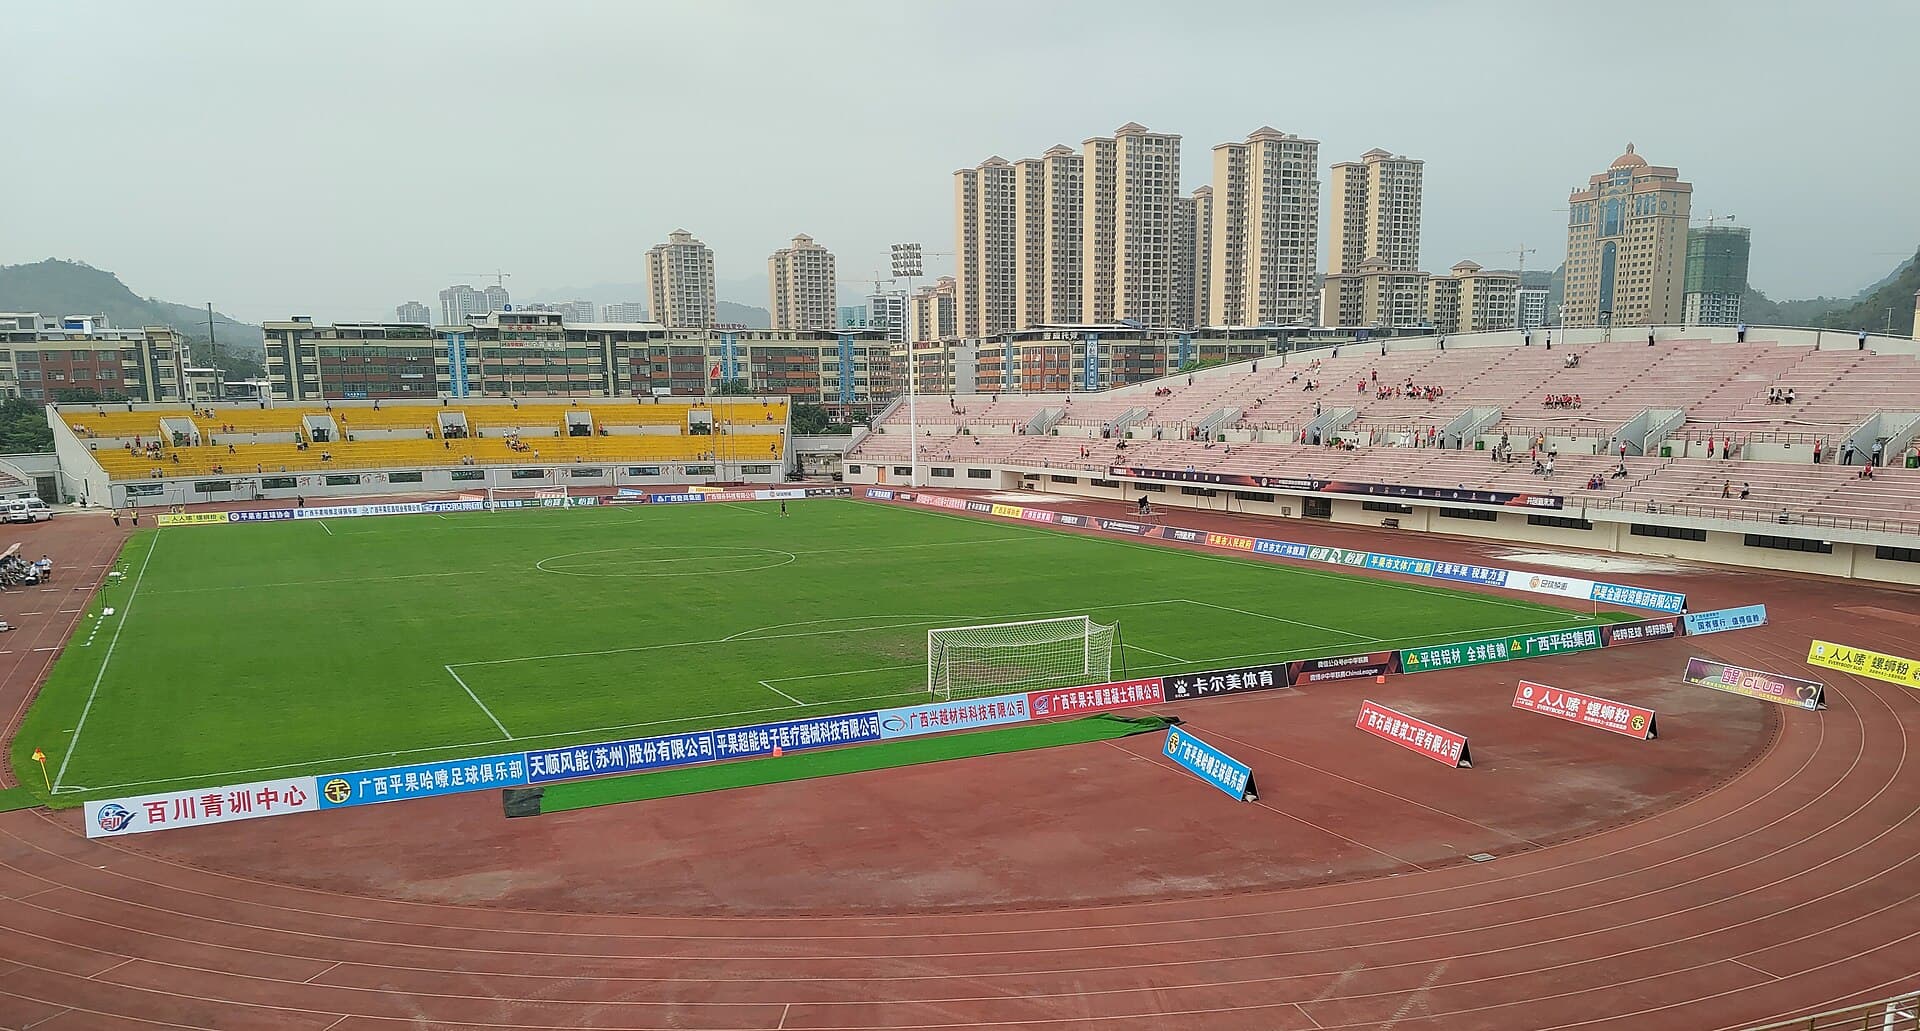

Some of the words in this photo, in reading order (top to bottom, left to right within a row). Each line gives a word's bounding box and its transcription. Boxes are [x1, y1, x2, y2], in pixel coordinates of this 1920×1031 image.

[1208, 534, 1252, 549] 平果市人民政府
[1420, 647, 1462, 668] 平铝铝材
[1467, 641, 1507, 663] 全球信赖
[1526, 629, 1596, 654] 广西平铝集团
[1193, 669, 1275, 694] 卡尔美体育
[1743, 676, 1785, 695] CLUB
[1052, 682, 1160, 714] 广西平果天厦混凝土有限公司
[1538, 689, 1580, 714] 人人嗦
[909, 699, 1027, 730] 广西兴越材料科技有限公司
[717, 715, 881, 755] 平果超能电子医疗器械科技有限公司
[1361, 708, 1462, 761] 广西石尚建筑工程有限公司
[530, 735, 714, 778] 天顺风能(苏州)股份有限公司
[358, 758, 525, 799] 广西平果哈嘹足球俱乐部
[143, 784, 308, 825] 百川青训中心
